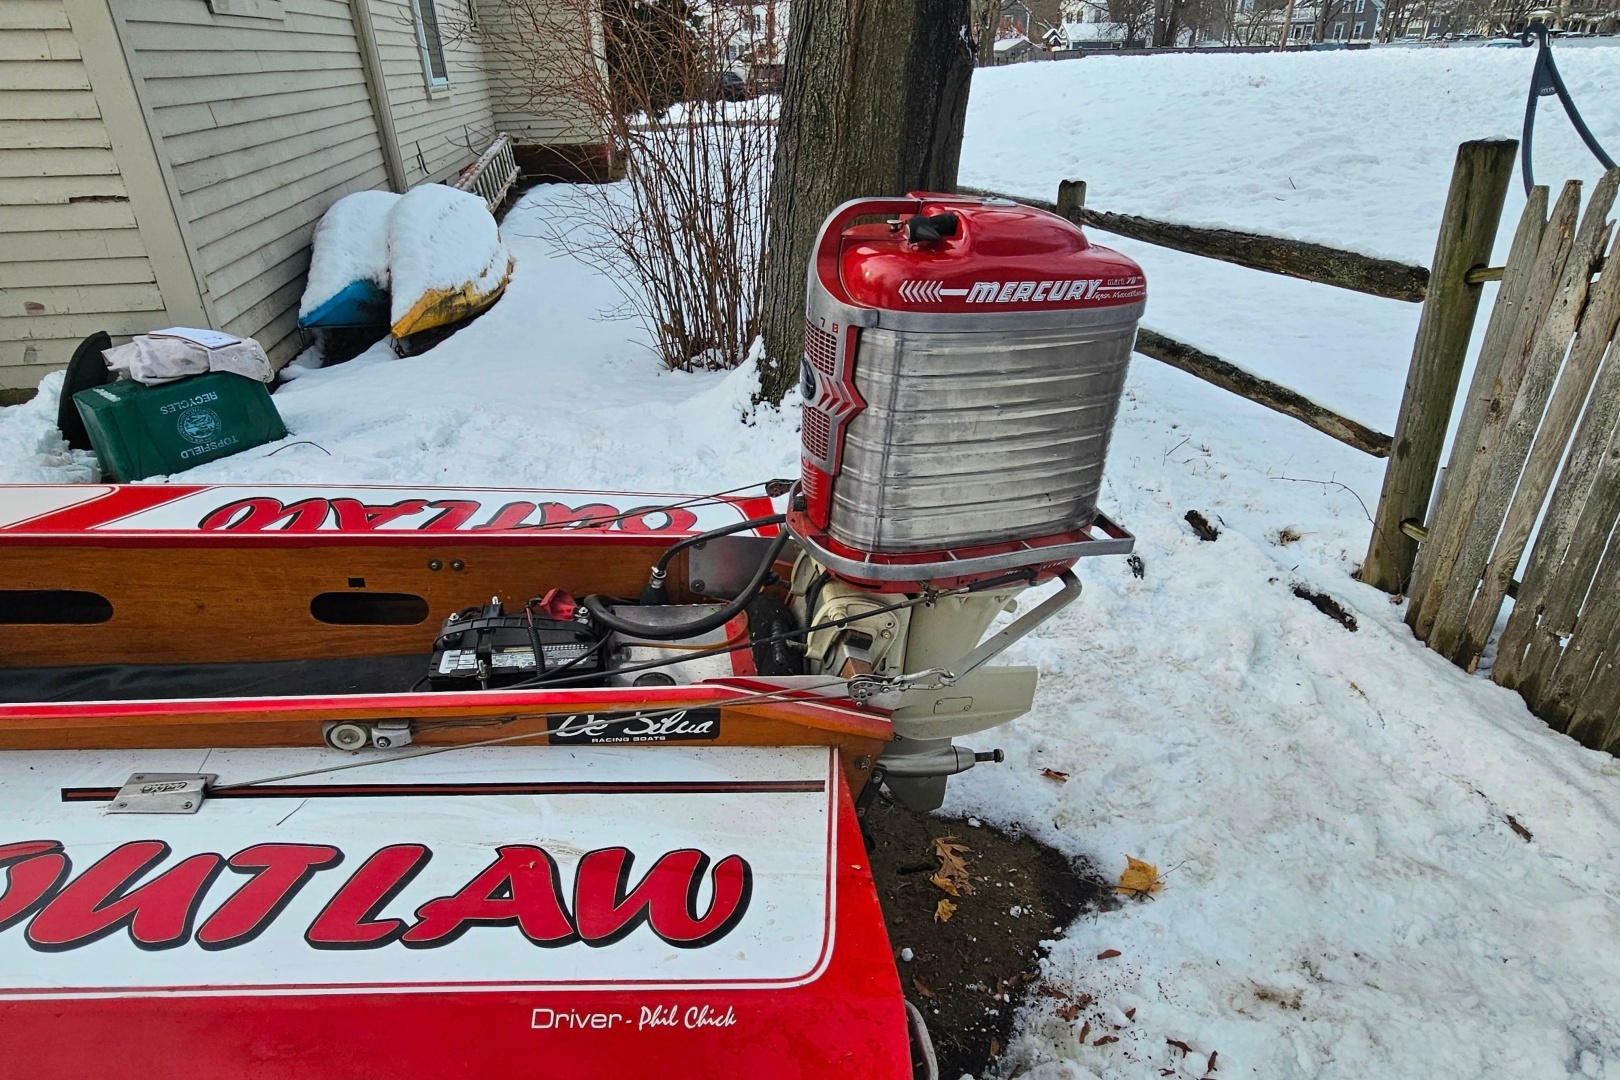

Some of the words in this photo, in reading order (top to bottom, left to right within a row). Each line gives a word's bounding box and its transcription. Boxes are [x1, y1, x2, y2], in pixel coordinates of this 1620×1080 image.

[965, 279, 1103, 302] MERCURY
[160, 391, 218, 415] RECYCLES
[180, 434, 239, 459] TOPSFIELD
[638, 1005, 680, 1031] Phil
[684, 1005, 737, 1029] Chick
